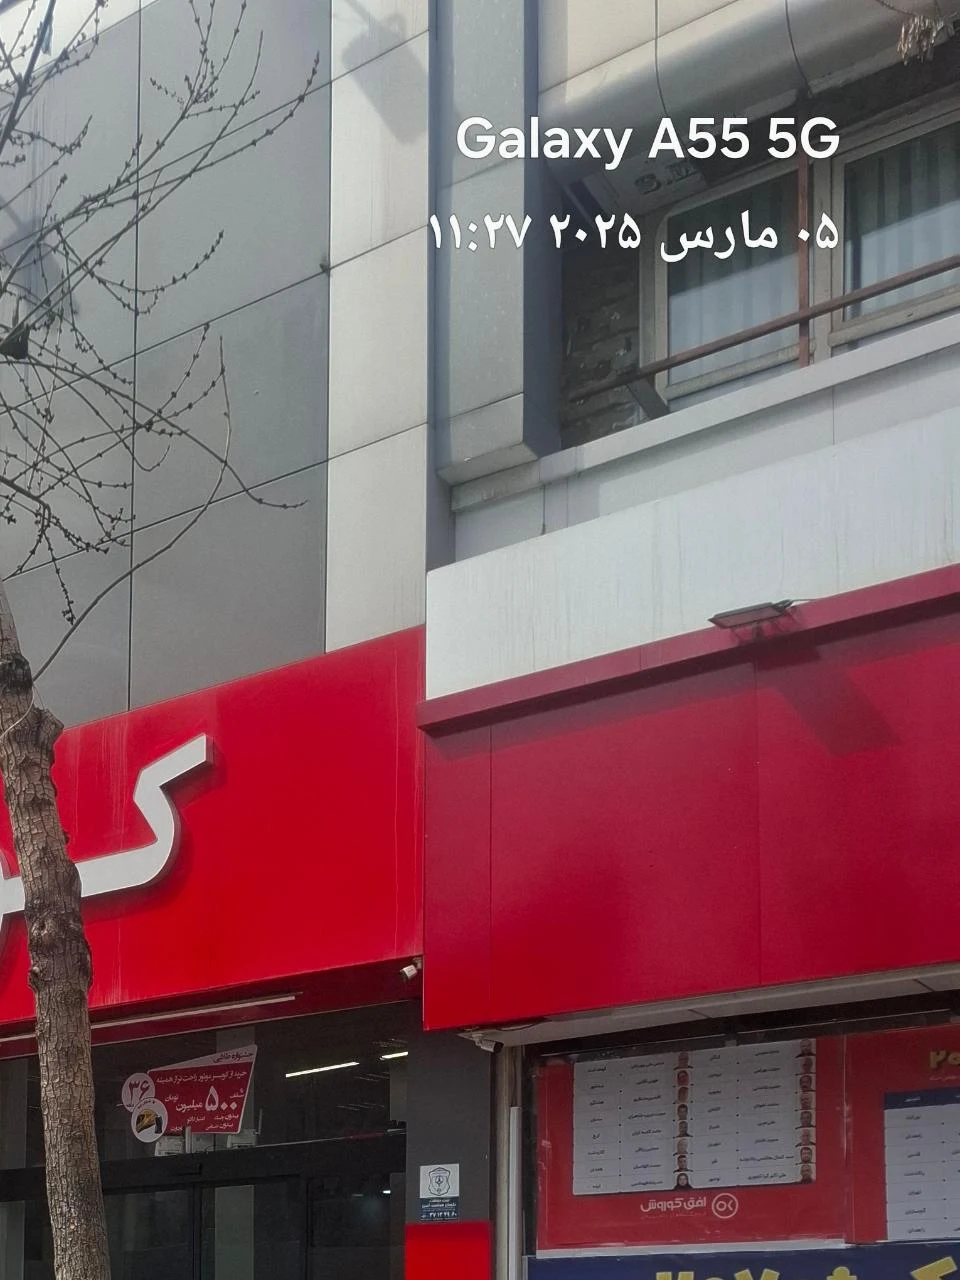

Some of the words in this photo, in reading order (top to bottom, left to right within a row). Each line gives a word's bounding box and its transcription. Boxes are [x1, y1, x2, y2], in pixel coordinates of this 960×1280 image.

[128, 1080, 150, 1104] ۳۶
[205, 1085, 238, 1111] ۵۰۰
[175, 1100, 203, 1113] میلیون
[639, 1197, 684, 1213] کوروش
[683, 1195, 707, 1211] افق
